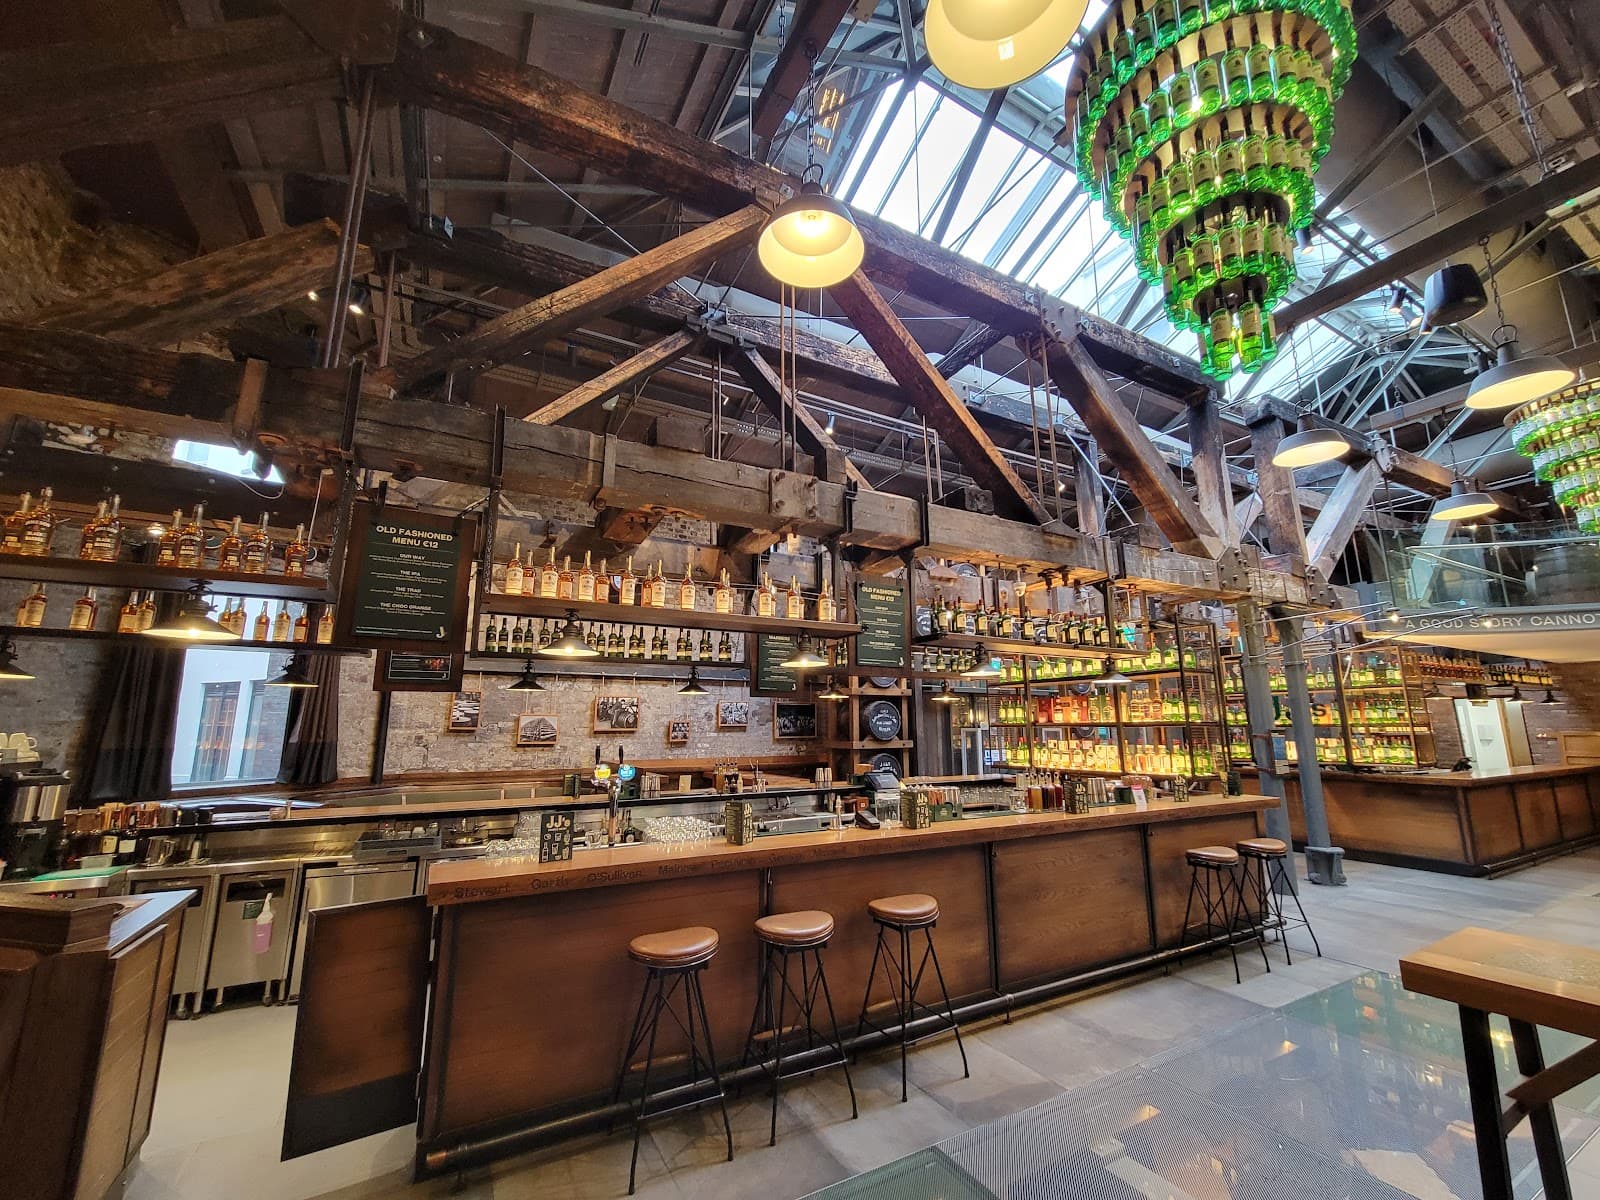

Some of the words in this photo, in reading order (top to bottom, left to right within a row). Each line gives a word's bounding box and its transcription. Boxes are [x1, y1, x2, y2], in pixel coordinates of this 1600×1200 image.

[376, 525, 397, 534] OLD
[399, 528, 453, 542] FASHIONED
[392, 536, 421, 546] MENU
[422, 540, 439, 549] €12
[1406, 618, 1416, 628] A
[1420, 618, 1464, 628] GOOD
[546, 814, 571, 829] JJ's
